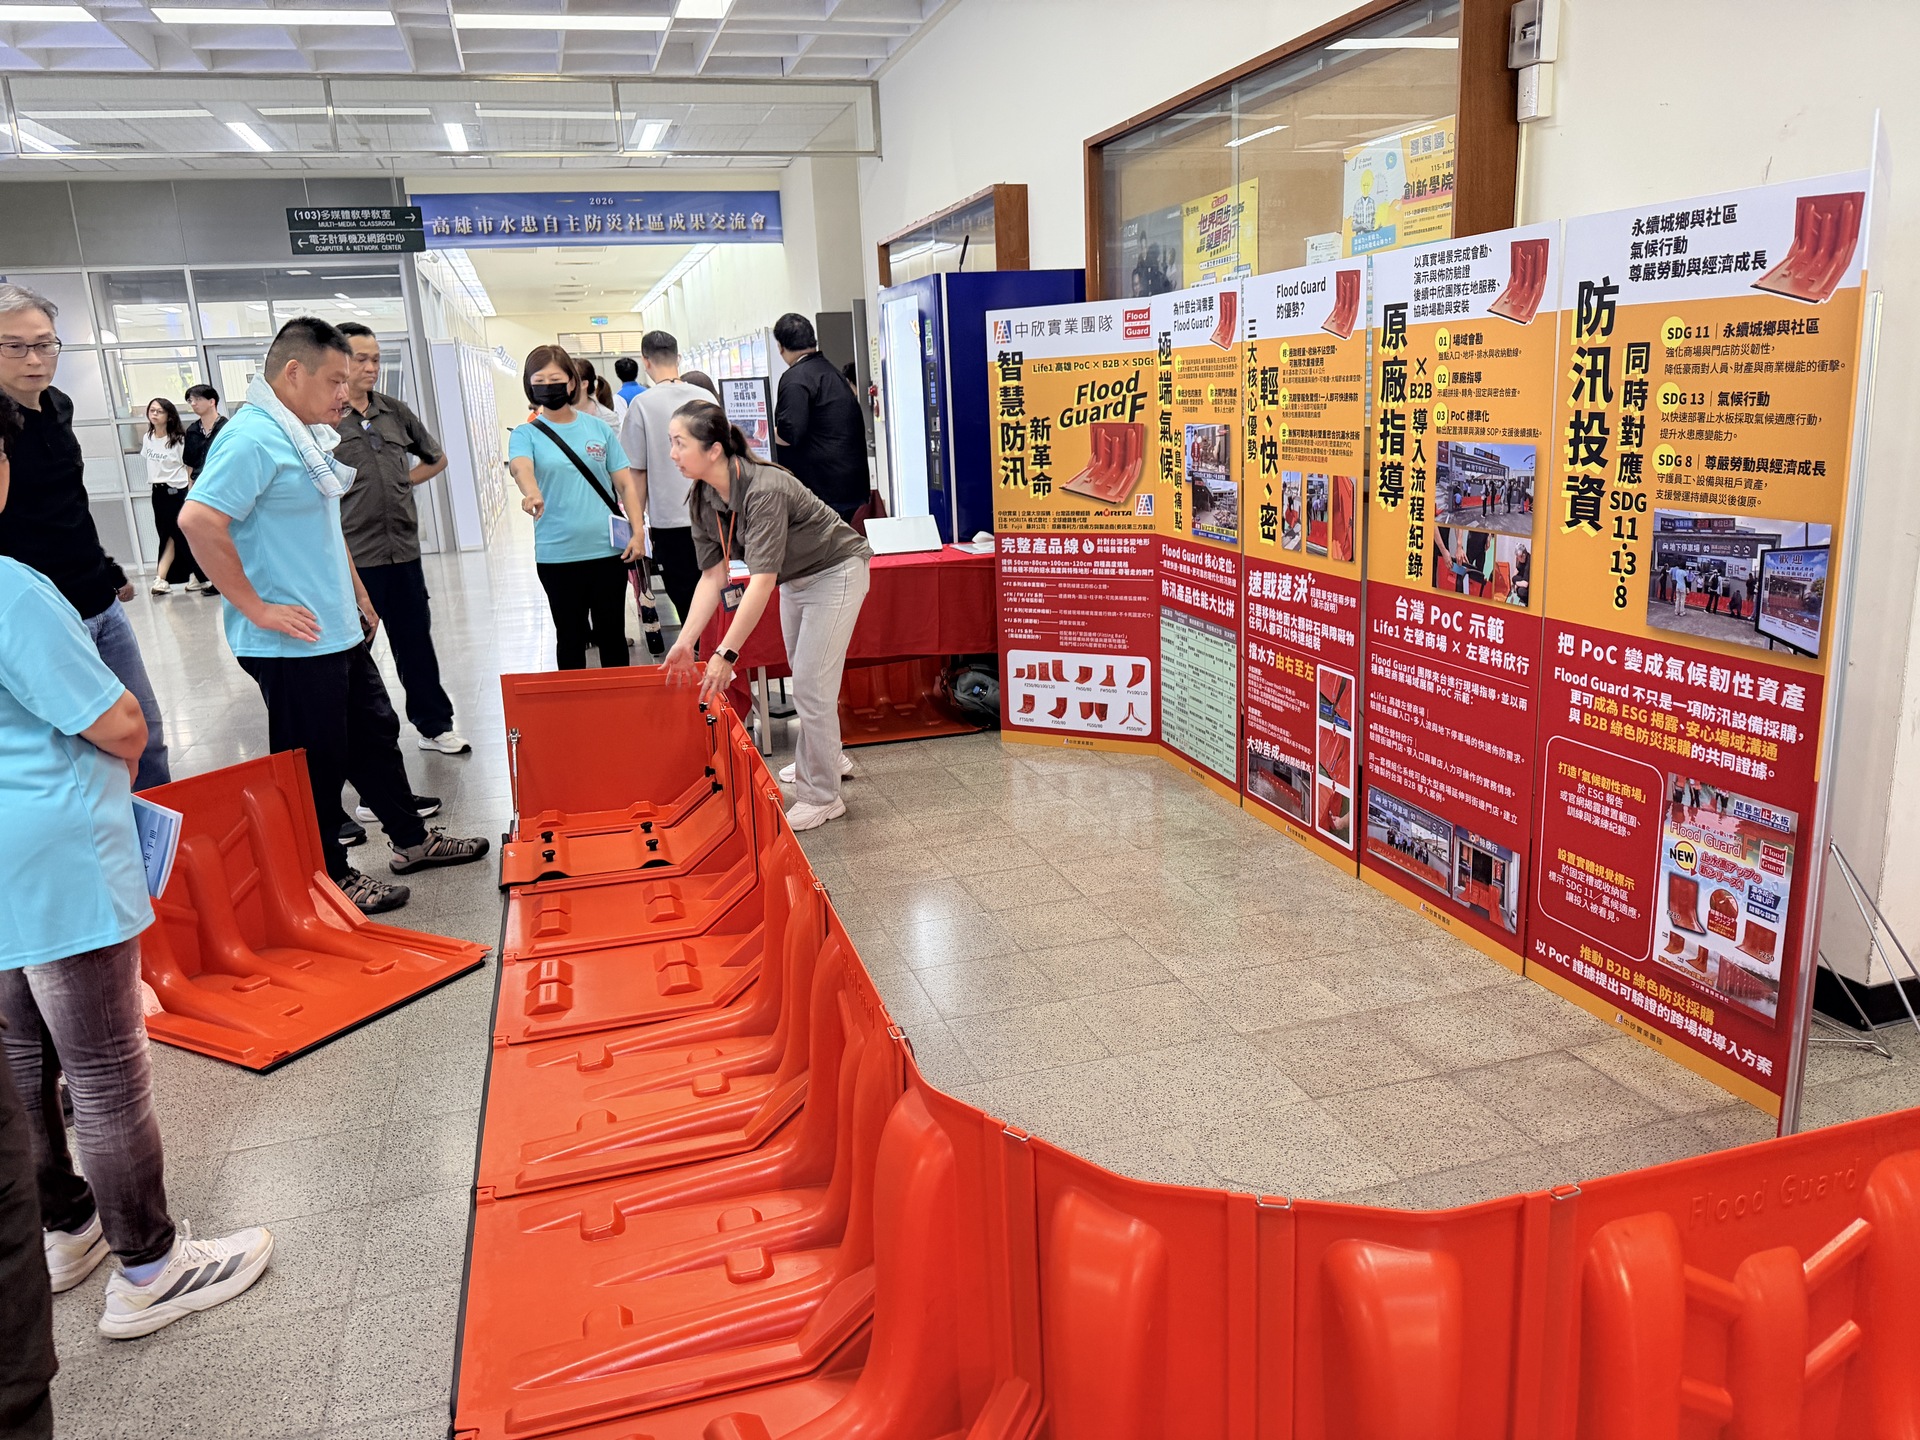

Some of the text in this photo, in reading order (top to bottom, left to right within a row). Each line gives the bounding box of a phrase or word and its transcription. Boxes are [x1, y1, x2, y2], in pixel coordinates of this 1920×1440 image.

[589, 197, 614, 205] 2026
[432, 211, 767, 236] 高雄市水患自主防災社區成果交流會
[1631, 203, 1738, 237] 永續城鄉與社區
[309, 234, 405, 244] 電子計算機及網路中心
[1629, 236, 1688, 260] 氣候行動
[1413, 265, 1470, 285] 演示與佈防驗證
[1628, 249, 1768, 283] 尊嚴勞動與經濟成長
[1276, 277, 1326, 299] Flood Guard
[1126, 311, 1149, 321] Flood
[1413, 300, 1470, 317] 協助場勘與安裝
[1015, 314, 1113, 338] 中欣實業團隊
[1126, 327, 1149, 337] Guard
[1174, 316, 1214, 332] Flood Guard?
[1666, 318, 1820, 340] SDG 11 永續城鄉與社區
[1438, 332, 1483, 346] 01 場域會勘
[1055, 361, 1072, 371] 高雄
[1074, 361, 1090, 370] PoC
[1102, 359, 1120, 369] B2B
[1077, 370, 1140, 405] Flood
[1247, 318, 1258, 460] 三大核心優勢
[1437, 372, 1482, 384] 02 原廠指導
[1157, 331, 1173, 480] 極端氣候
[1379, 302, 1408, 507] 原廠指導
[1566, 276, 1619, 532] 防汛投資
[1662, 391, 1770, 407] SDG 13 氣候行動
[997, 350, 1028, 487] 智慧防汛
[1436, 411, 1490, 422] 03 PoC 標準化
[1609, 342, 1651, 513] 同時對應 SDG
[1659, 428, 1738, 442] 提升水患應變能力。
[1030, 416, 1053, 496] 新革命
[1658, 454, 1826, 477] SDG 8 尊嚴勞動與經濟成長
[1407, 383, 1432, 578] B2B 導入流程紀錄
[1655, 489, 1762, 508] 支援營運持續與災後復原。
[1001, 537, 1079, 555] 完整產品線
[1161, 543, 1203, 565] Flood Guard
[1161, 579, 1235, 619] 防汛產品性能大比拼
[1248, 570, 1308, 604] 速戰速決
[1395, 595, 1504, 644] 台灣 PoC 示範
[1248, 616, 1321, 651] 任何人都可以快速組裝
[1373, 619, 1530, 676] Life1 左營商場 左營特欣行
[1371, 653, 1392, 667] Flood
[1393, 658, 1416, 675] Guard
[1557, 632, 1806, 712] 把 PoC 變成氣候韌性資產
[1436, 684, 1452, 699] PoC
[1554, 667, 1588, 687] Flood
[1590, 677, 1629, 698] Guard
[1568, 707, 1581, 724] 與
[1583, 714, 1608, 732] B2B
[1570, 689, 1778, 761] 更可成為 ESG 揭露、安心場域溝通
[1404, 778, 1416, 790] B2B
[1577, 782, 1624, 808] 於 ESG 報告
[1670, 821, 1741, 857] Flood Guard
[1669, 848, 1694, 864] NEW
[1763, 845, 1785, 861] Flood
[1557, 847, 1636, 891] 設置實體視覺標示
[1761, 859, 1784, 874] Guard
[1548, 871, 1582, 892] 標示 SDG
[1580, 943, 1604, 969] 推動
[1606, 957, 1631, 981] B2B
[1632, 970, 1715, 1026] 綠色防災採購
[1535, 938, 1547, 955] 以
[1548, 946, 1570, 968] PoC
[1572, 959, 1774, 1077] 證據提出可驗證的跨場域導入方案
[1689, 1157, 1861, 1230] Flood Guard
